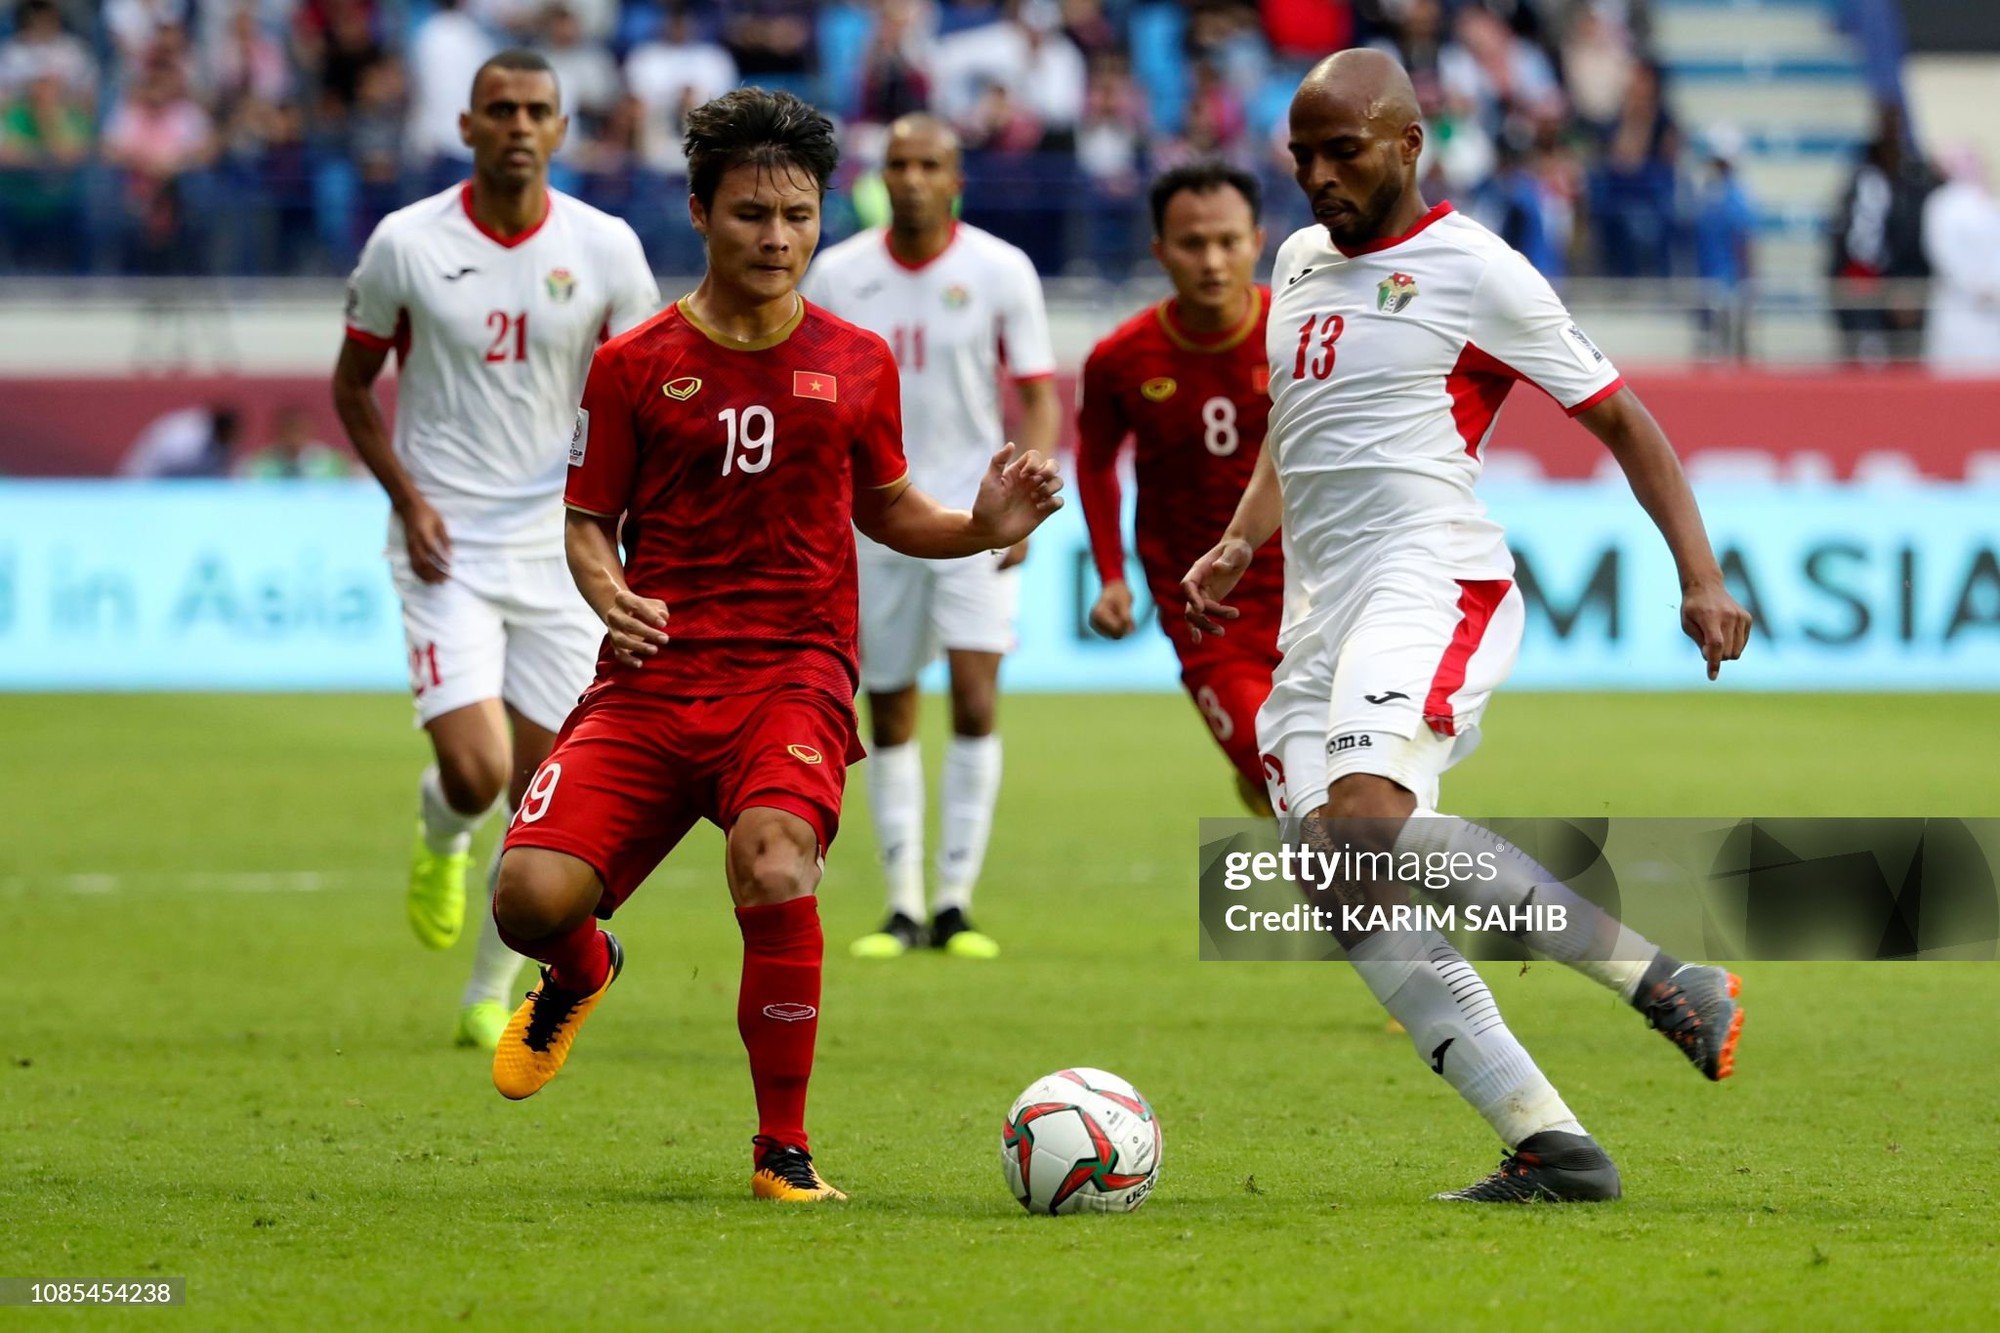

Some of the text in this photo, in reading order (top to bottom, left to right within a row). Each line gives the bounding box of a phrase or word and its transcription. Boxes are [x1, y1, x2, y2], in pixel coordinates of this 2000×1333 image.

[485, 310, 529, 364] 21
[892, 325, 928, 373] 11
[1292, 314, 1344, 380] 13
[718, 405, 774, 476] 19
[1202, 396, 1239, 456] 8
[1198, 686, 1233, 741] 8
[1327, 734, 1372, 754] oma
